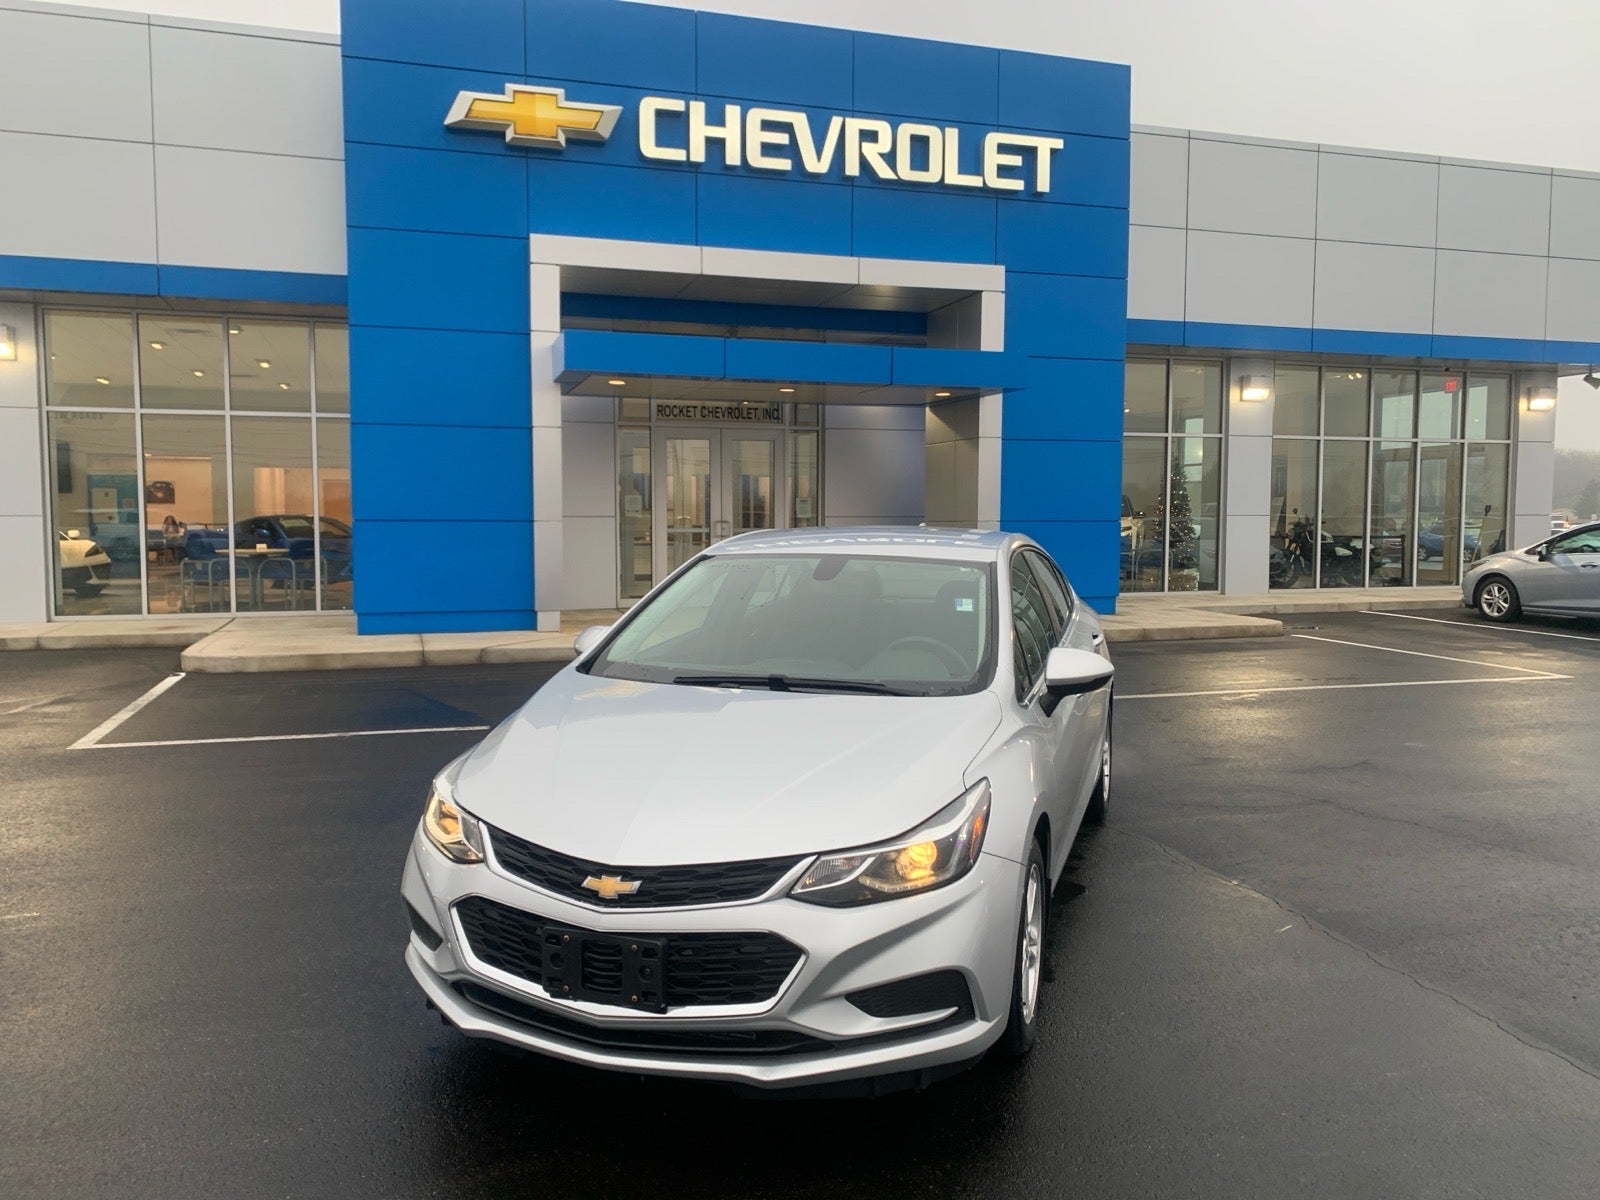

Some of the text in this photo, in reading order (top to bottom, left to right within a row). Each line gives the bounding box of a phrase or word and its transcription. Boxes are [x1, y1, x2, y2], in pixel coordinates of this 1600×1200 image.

[639, 96, 1064, 193] CHEVROLET
[656, 404, 698, 418] ROCKET
[700, 406, 760, 420] CHEVROLET,
